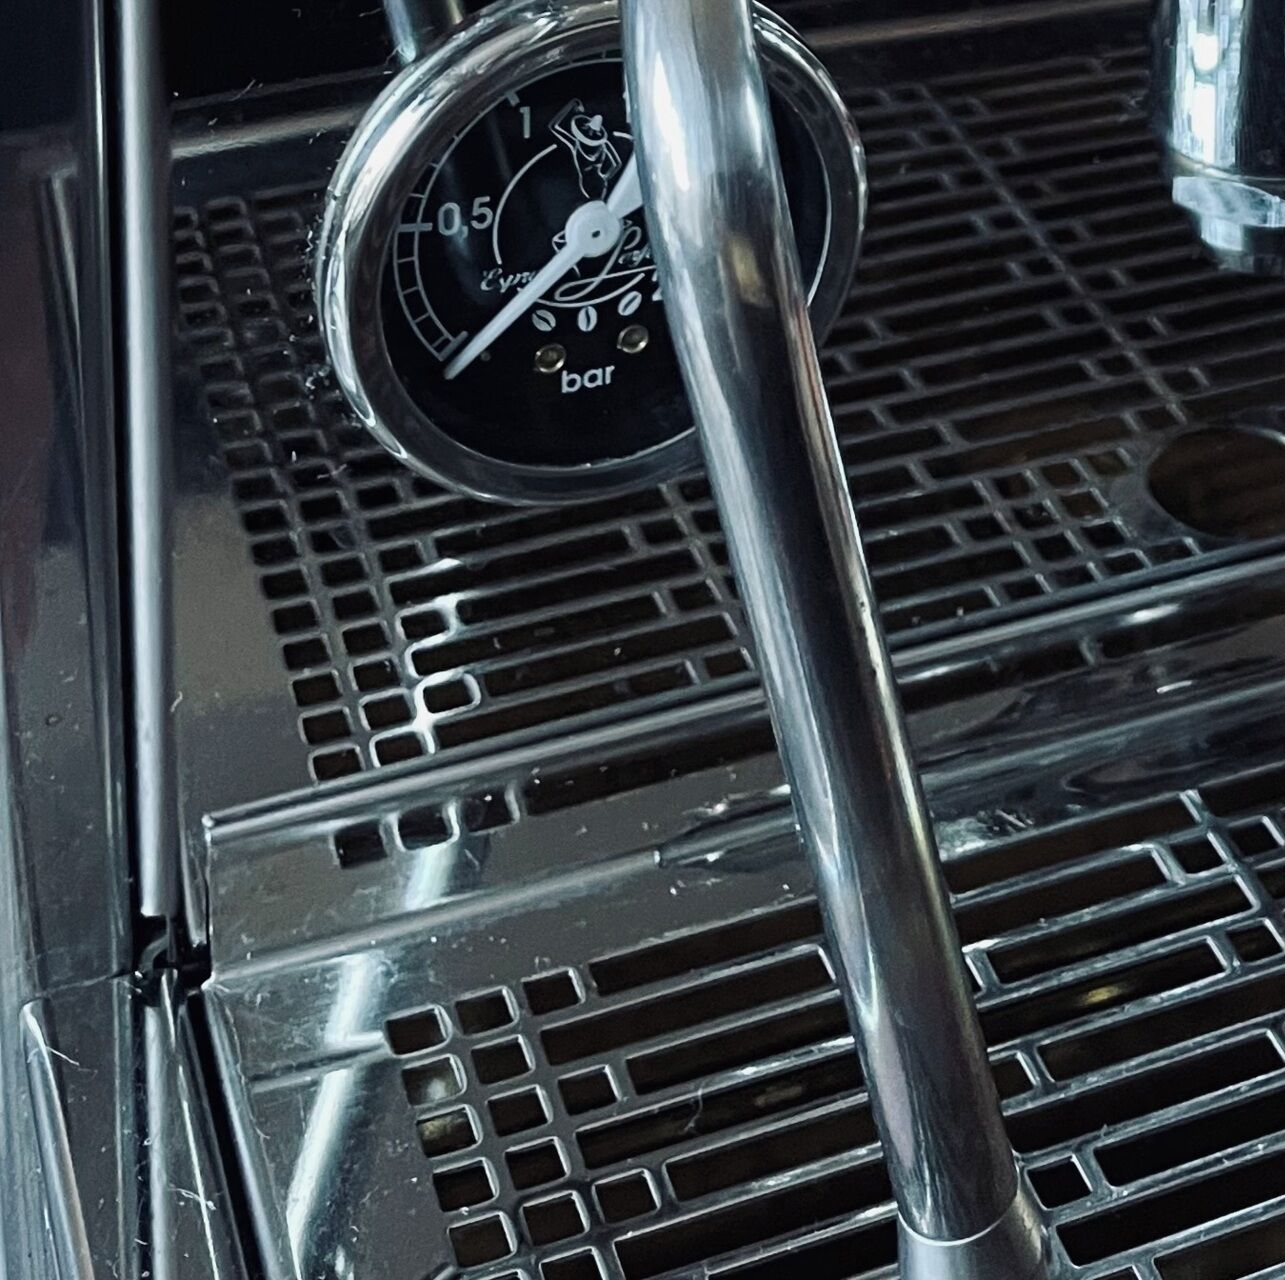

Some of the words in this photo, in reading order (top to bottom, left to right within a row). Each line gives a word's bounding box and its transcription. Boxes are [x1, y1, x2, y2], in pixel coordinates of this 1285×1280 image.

[519, 106, 531, 138] 1
[438, 196, 494, 237] 0,5
[560, 365, 615, 394] bar
